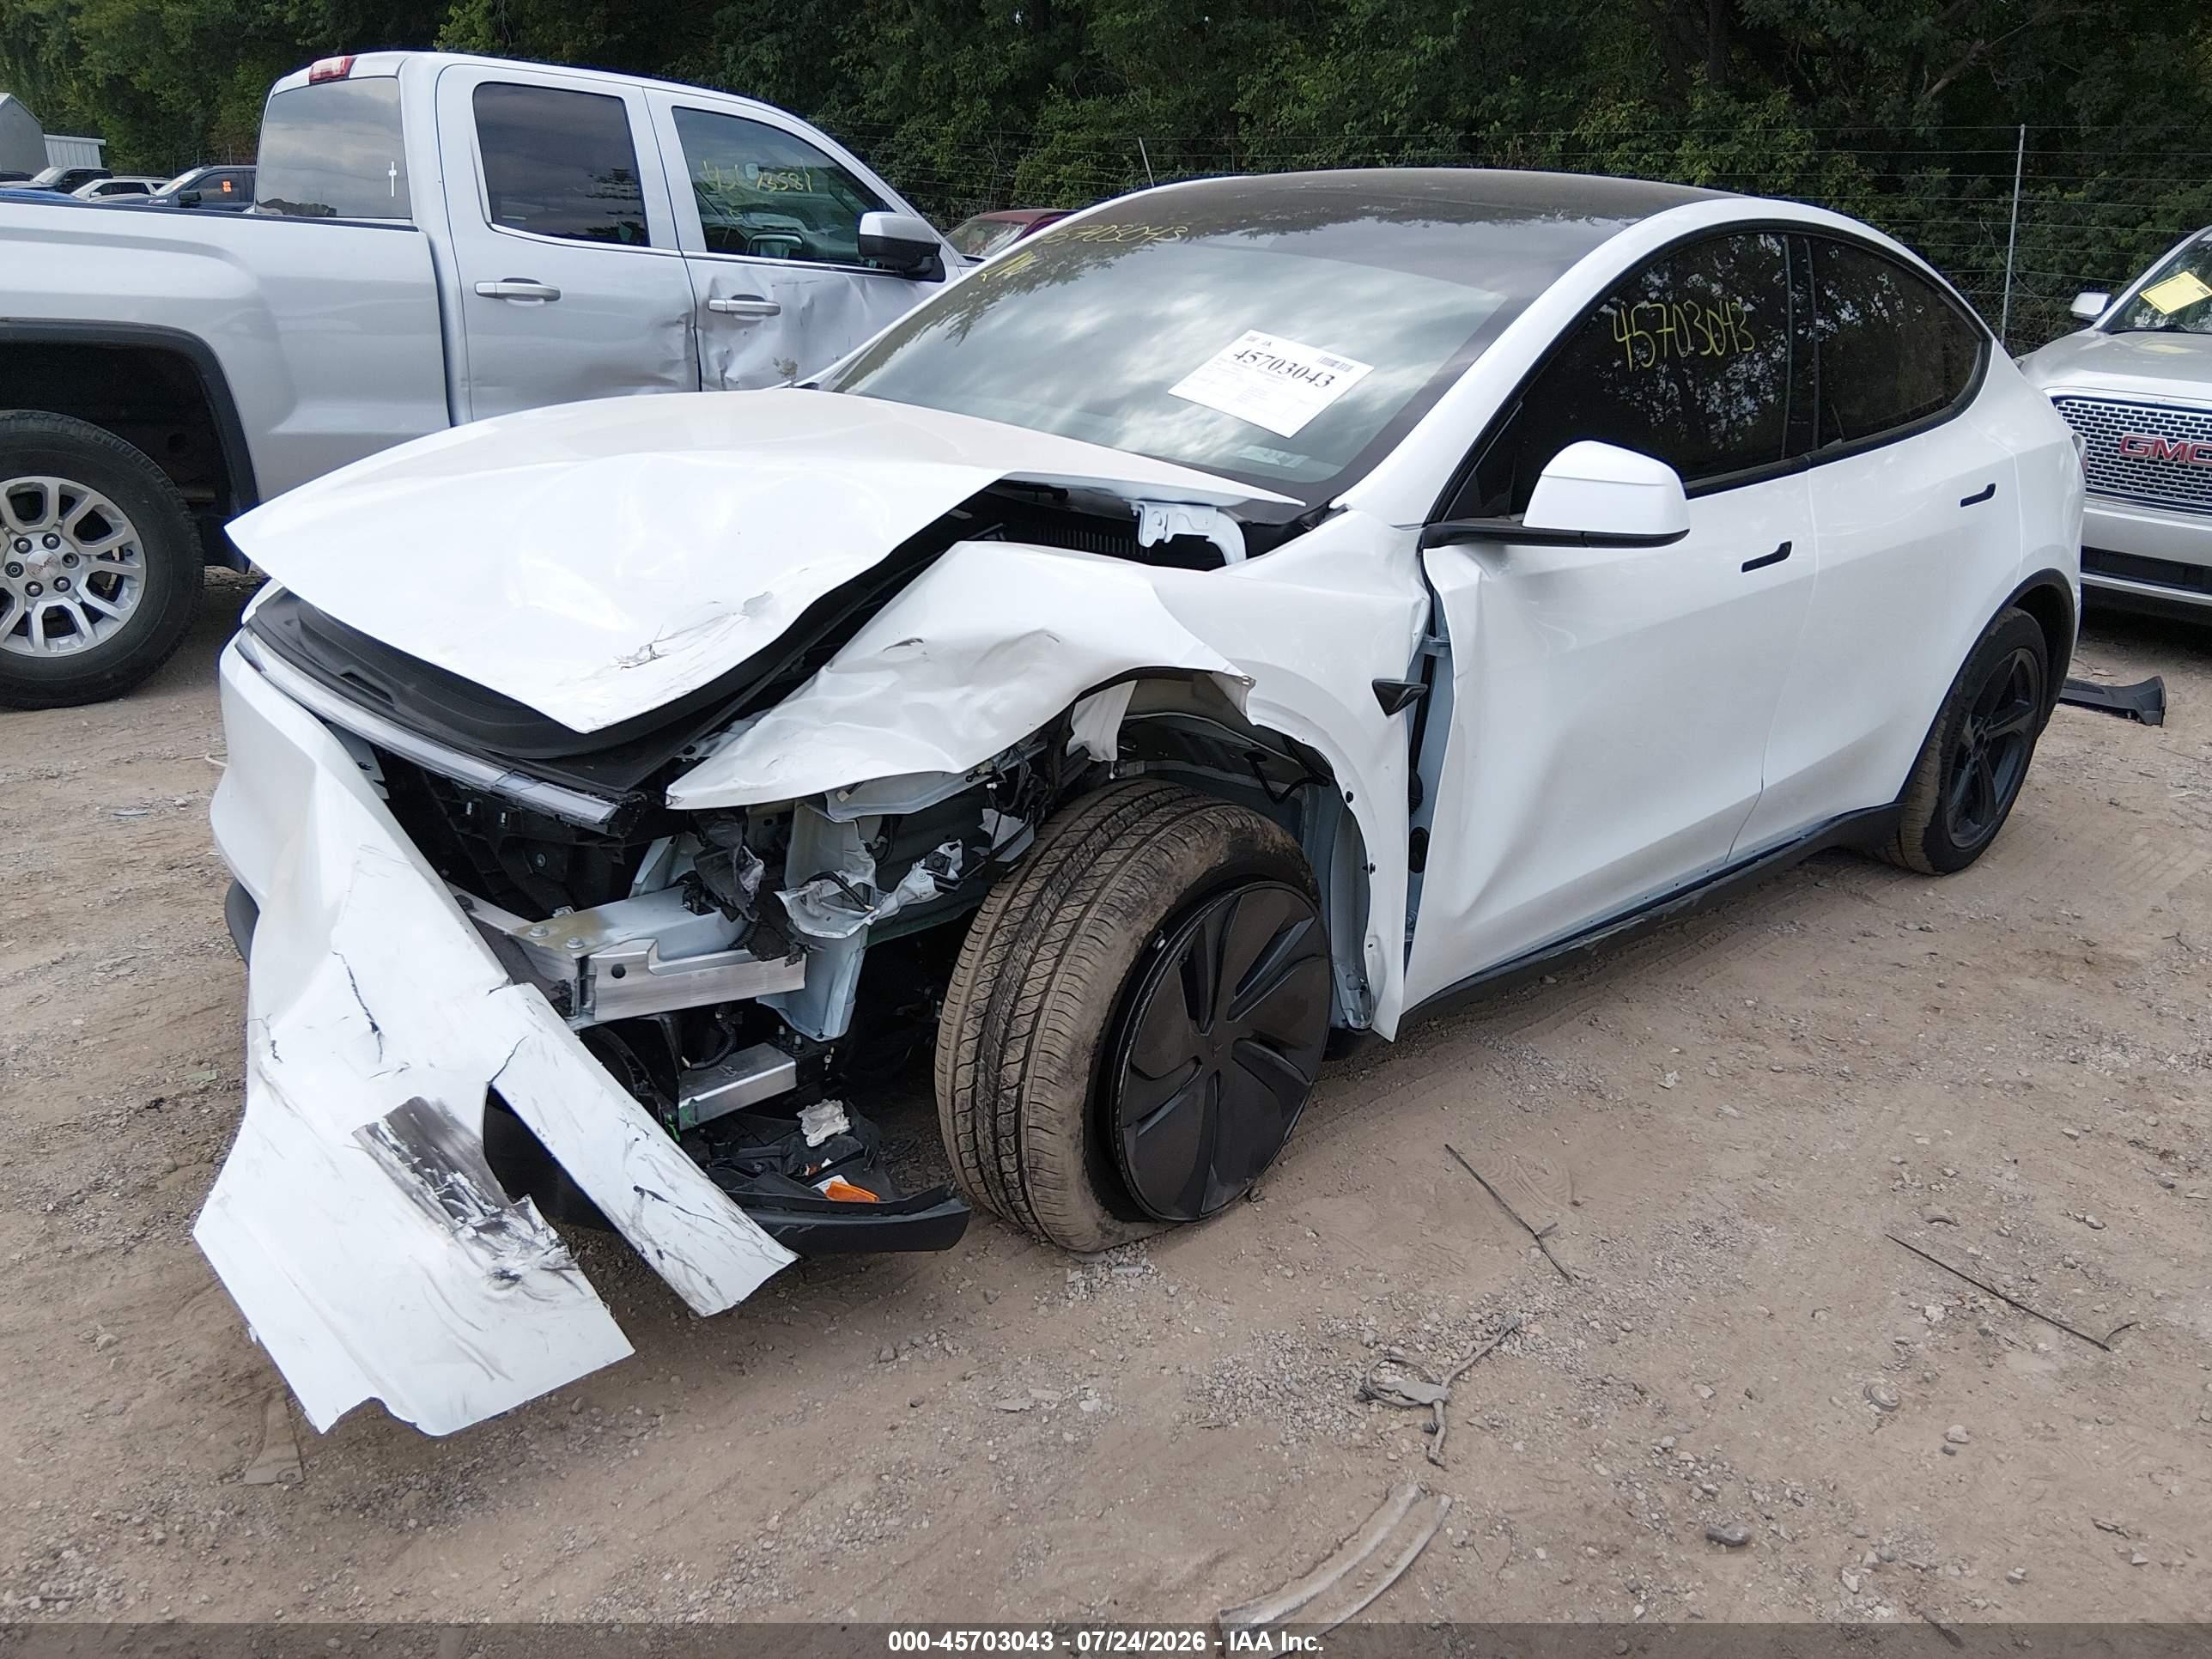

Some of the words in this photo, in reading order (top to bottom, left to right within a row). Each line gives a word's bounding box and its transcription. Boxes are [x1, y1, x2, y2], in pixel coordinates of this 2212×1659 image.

[1612, 298, 1756, 372] 45703043
[1233, 349, 1336, 388] 45703043
[2118, 434, 2212, 465] GMC
[31, 555, 57, 576] GMC
